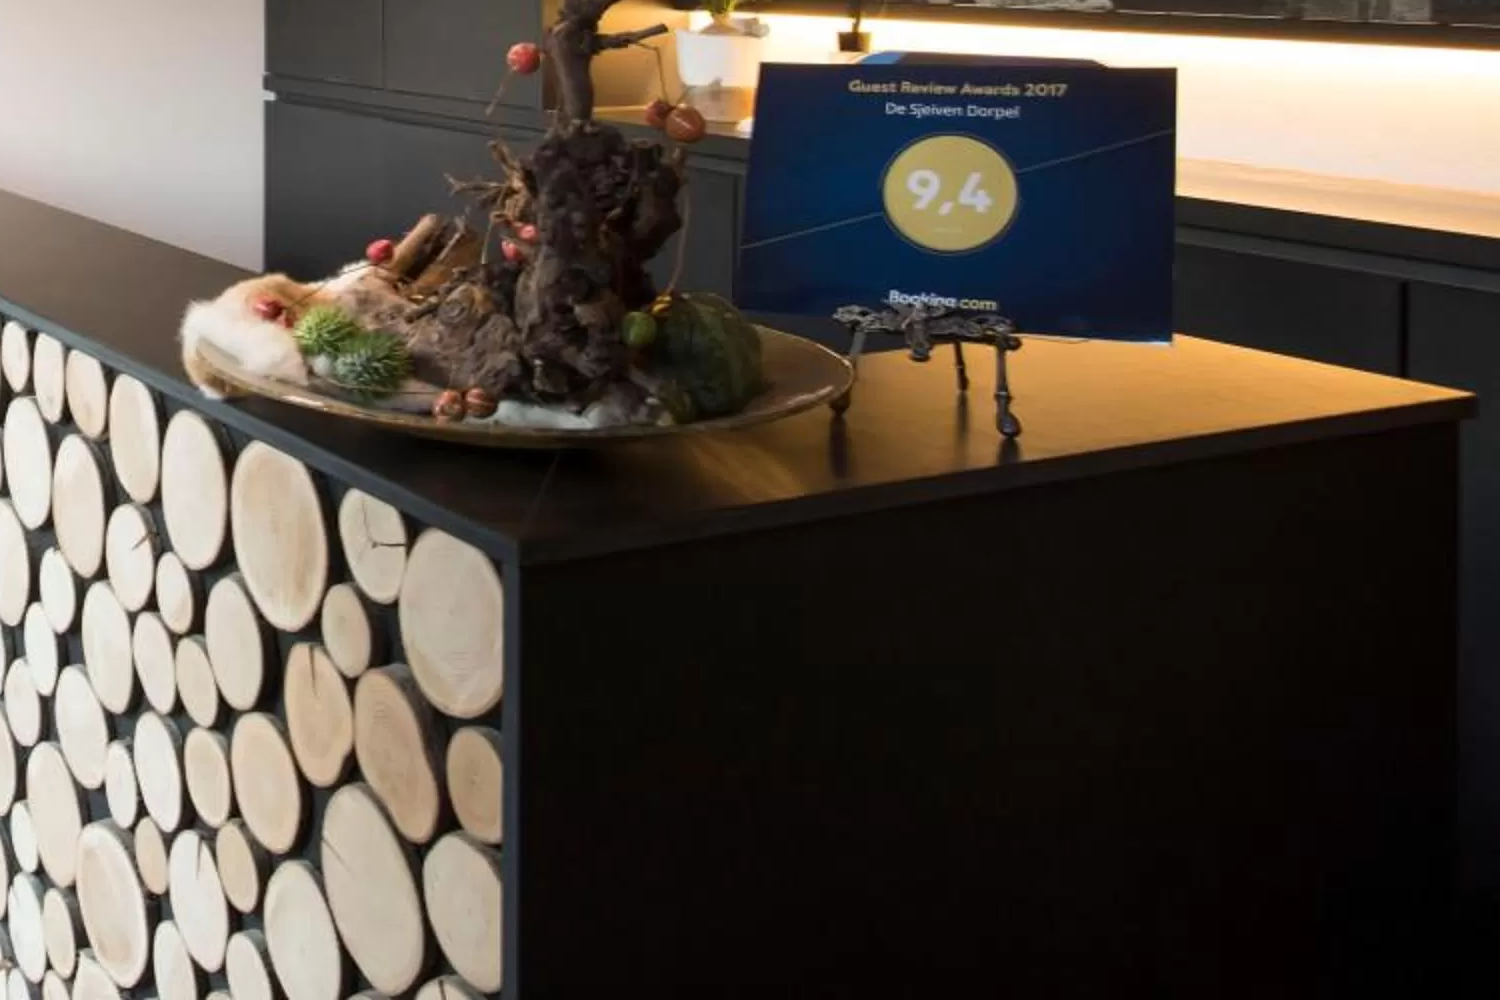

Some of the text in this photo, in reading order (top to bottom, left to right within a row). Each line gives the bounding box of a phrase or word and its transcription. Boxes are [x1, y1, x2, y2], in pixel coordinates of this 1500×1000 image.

[848, 79, 1068, 97] Guest Review Awards 2017
[885, 102, 906, 115] De
[907, 168, 992, 216] 9,4
[889, 289, 997, 311] Bookingcom
